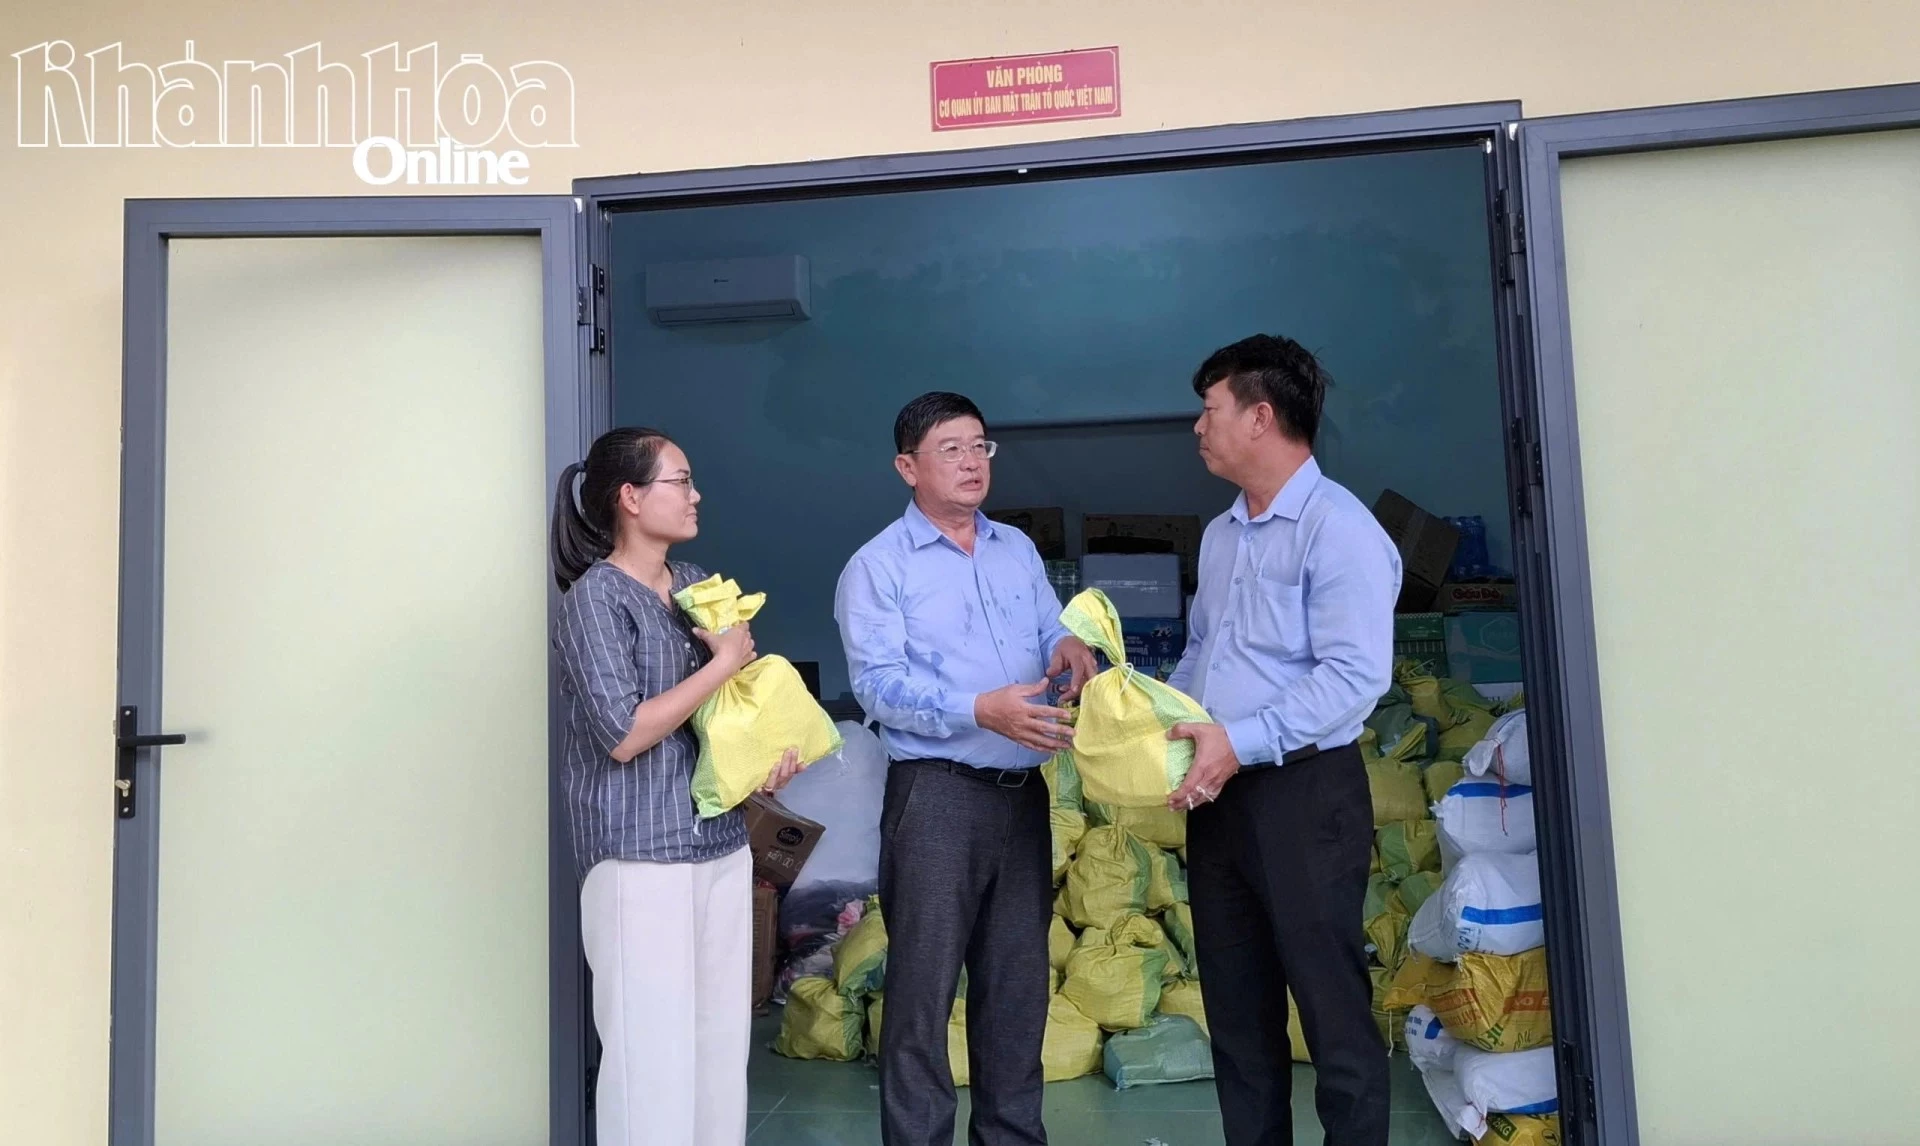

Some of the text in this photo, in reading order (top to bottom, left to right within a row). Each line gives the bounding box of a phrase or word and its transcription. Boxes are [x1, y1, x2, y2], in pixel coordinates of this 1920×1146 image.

[986, 61, 1063, 88] VĂN PHÒNG
[939, 83, 1113, 119] CƠ QUAN ỦY BAN MẶT TRẬN TỔ QUỐC VIỆT NAM
